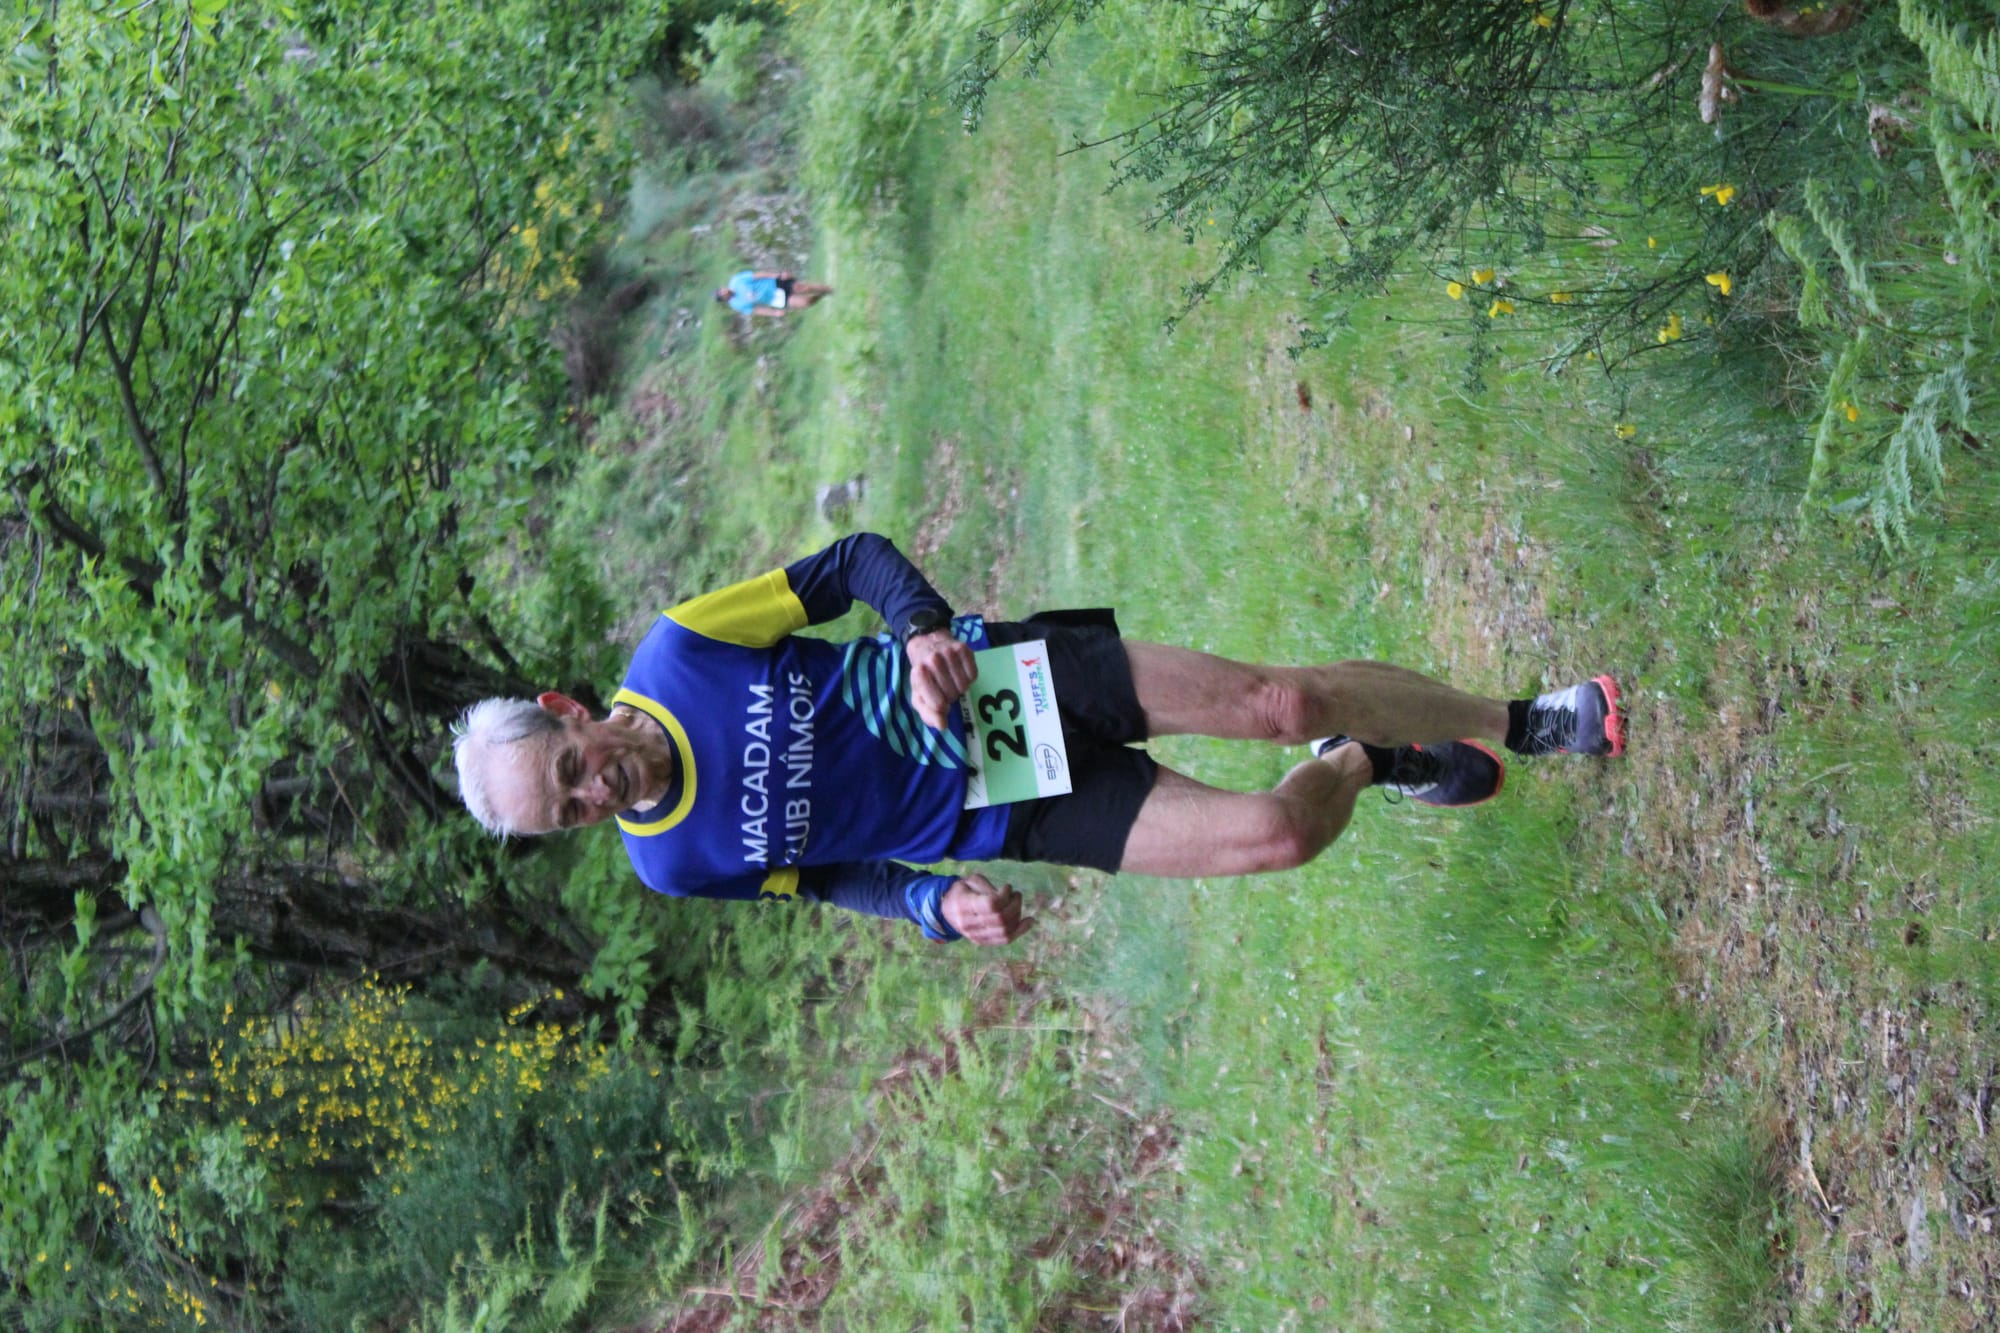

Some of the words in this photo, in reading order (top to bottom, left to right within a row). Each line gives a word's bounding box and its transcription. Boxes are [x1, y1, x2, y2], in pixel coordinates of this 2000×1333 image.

[741, 684, 774, 862] MACADAM
[778, 672, 815, 788] NÎMOIS
[978, 689, 1029, 761] 23
